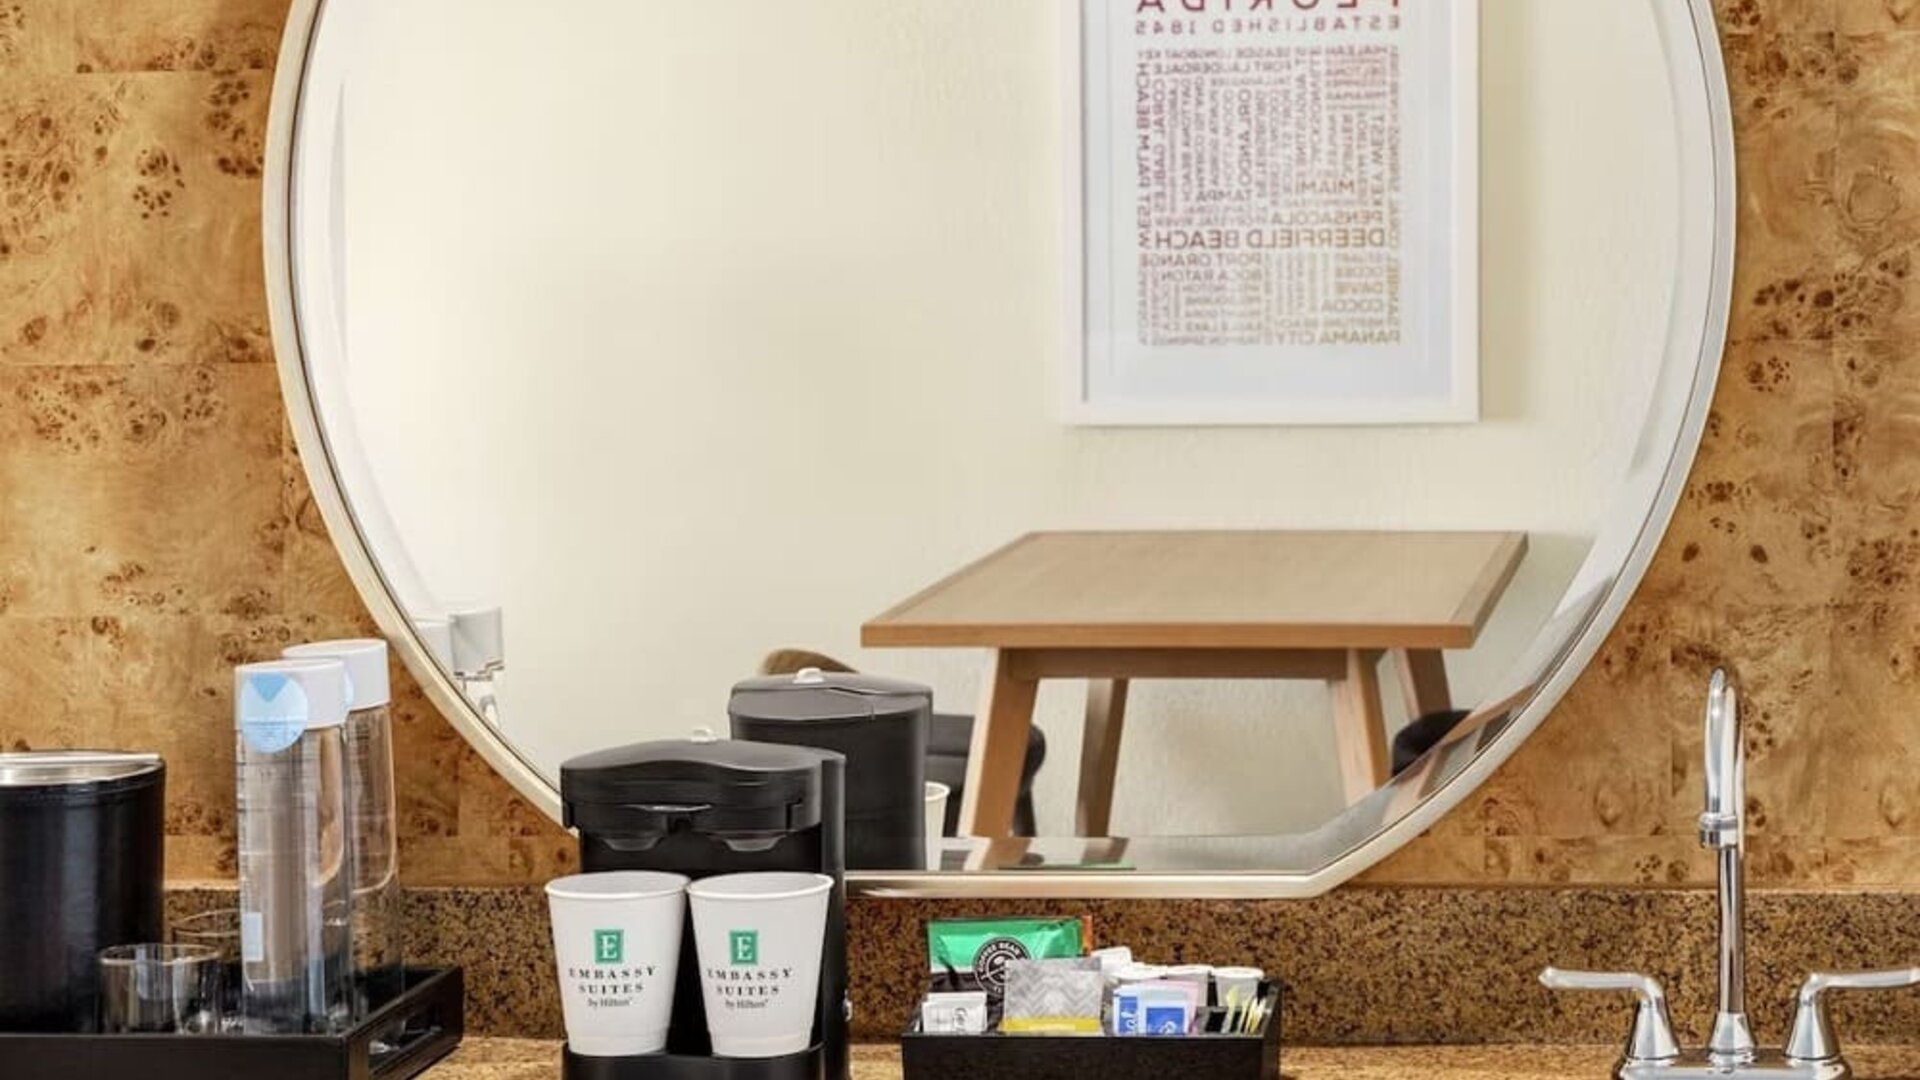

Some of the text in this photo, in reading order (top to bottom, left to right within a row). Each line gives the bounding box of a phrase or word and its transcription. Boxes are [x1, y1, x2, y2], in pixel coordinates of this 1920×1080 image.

[601, 934, 618, 960] E
[737, 936, 753, 960] E
[568, 966, 657, 979] EMBASSY
[707, 967, 793, 980] EMBASSY
[578, 983, 643, 995] SUITES
[717, 985, 779, 997] SUITES
